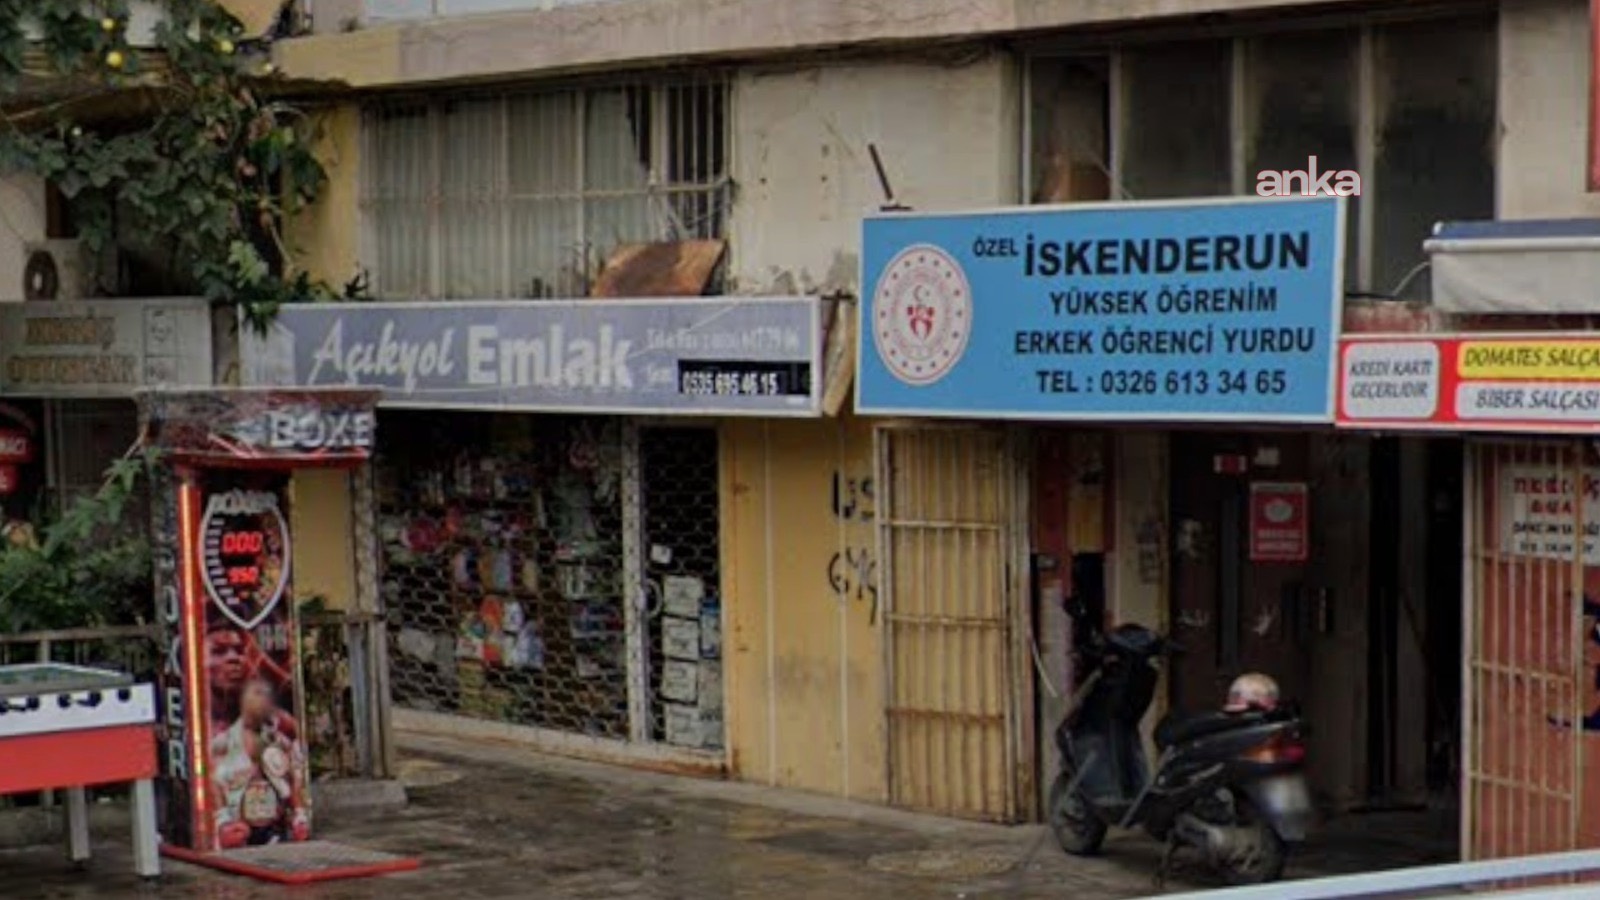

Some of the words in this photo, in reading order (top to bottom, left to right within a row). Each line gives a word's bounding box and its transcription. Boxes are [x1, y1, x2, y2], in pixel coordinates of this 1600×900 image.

[973, 235, 1019, 257] ÖZEL
[1024, 232, 1310, 276] İSKENDERUN
[1049, 286, 1148, 316] YÜKSEK
[1156, 281, 1278, 314] ÖĞRENİM
[307, 317, 456, 394] Açıkyol
[467, 324, 633, 388] Emlak
[1014, 330, 1094, 355] ERKEK
[1101, 324, 1214, 354] ÖĞRENCİ
[1222, 326, 1315, 353] YURDU
[1465, 347, 1543, 367] DOMATES
[1035, 369, 1079, 393] TEL
[1101, 369, 1157, 395] 0326
[1164, 369, 1209, 395] 613
[1217, 369, 1247, 395] 34
[1255, 369, 1286, 395] 65
